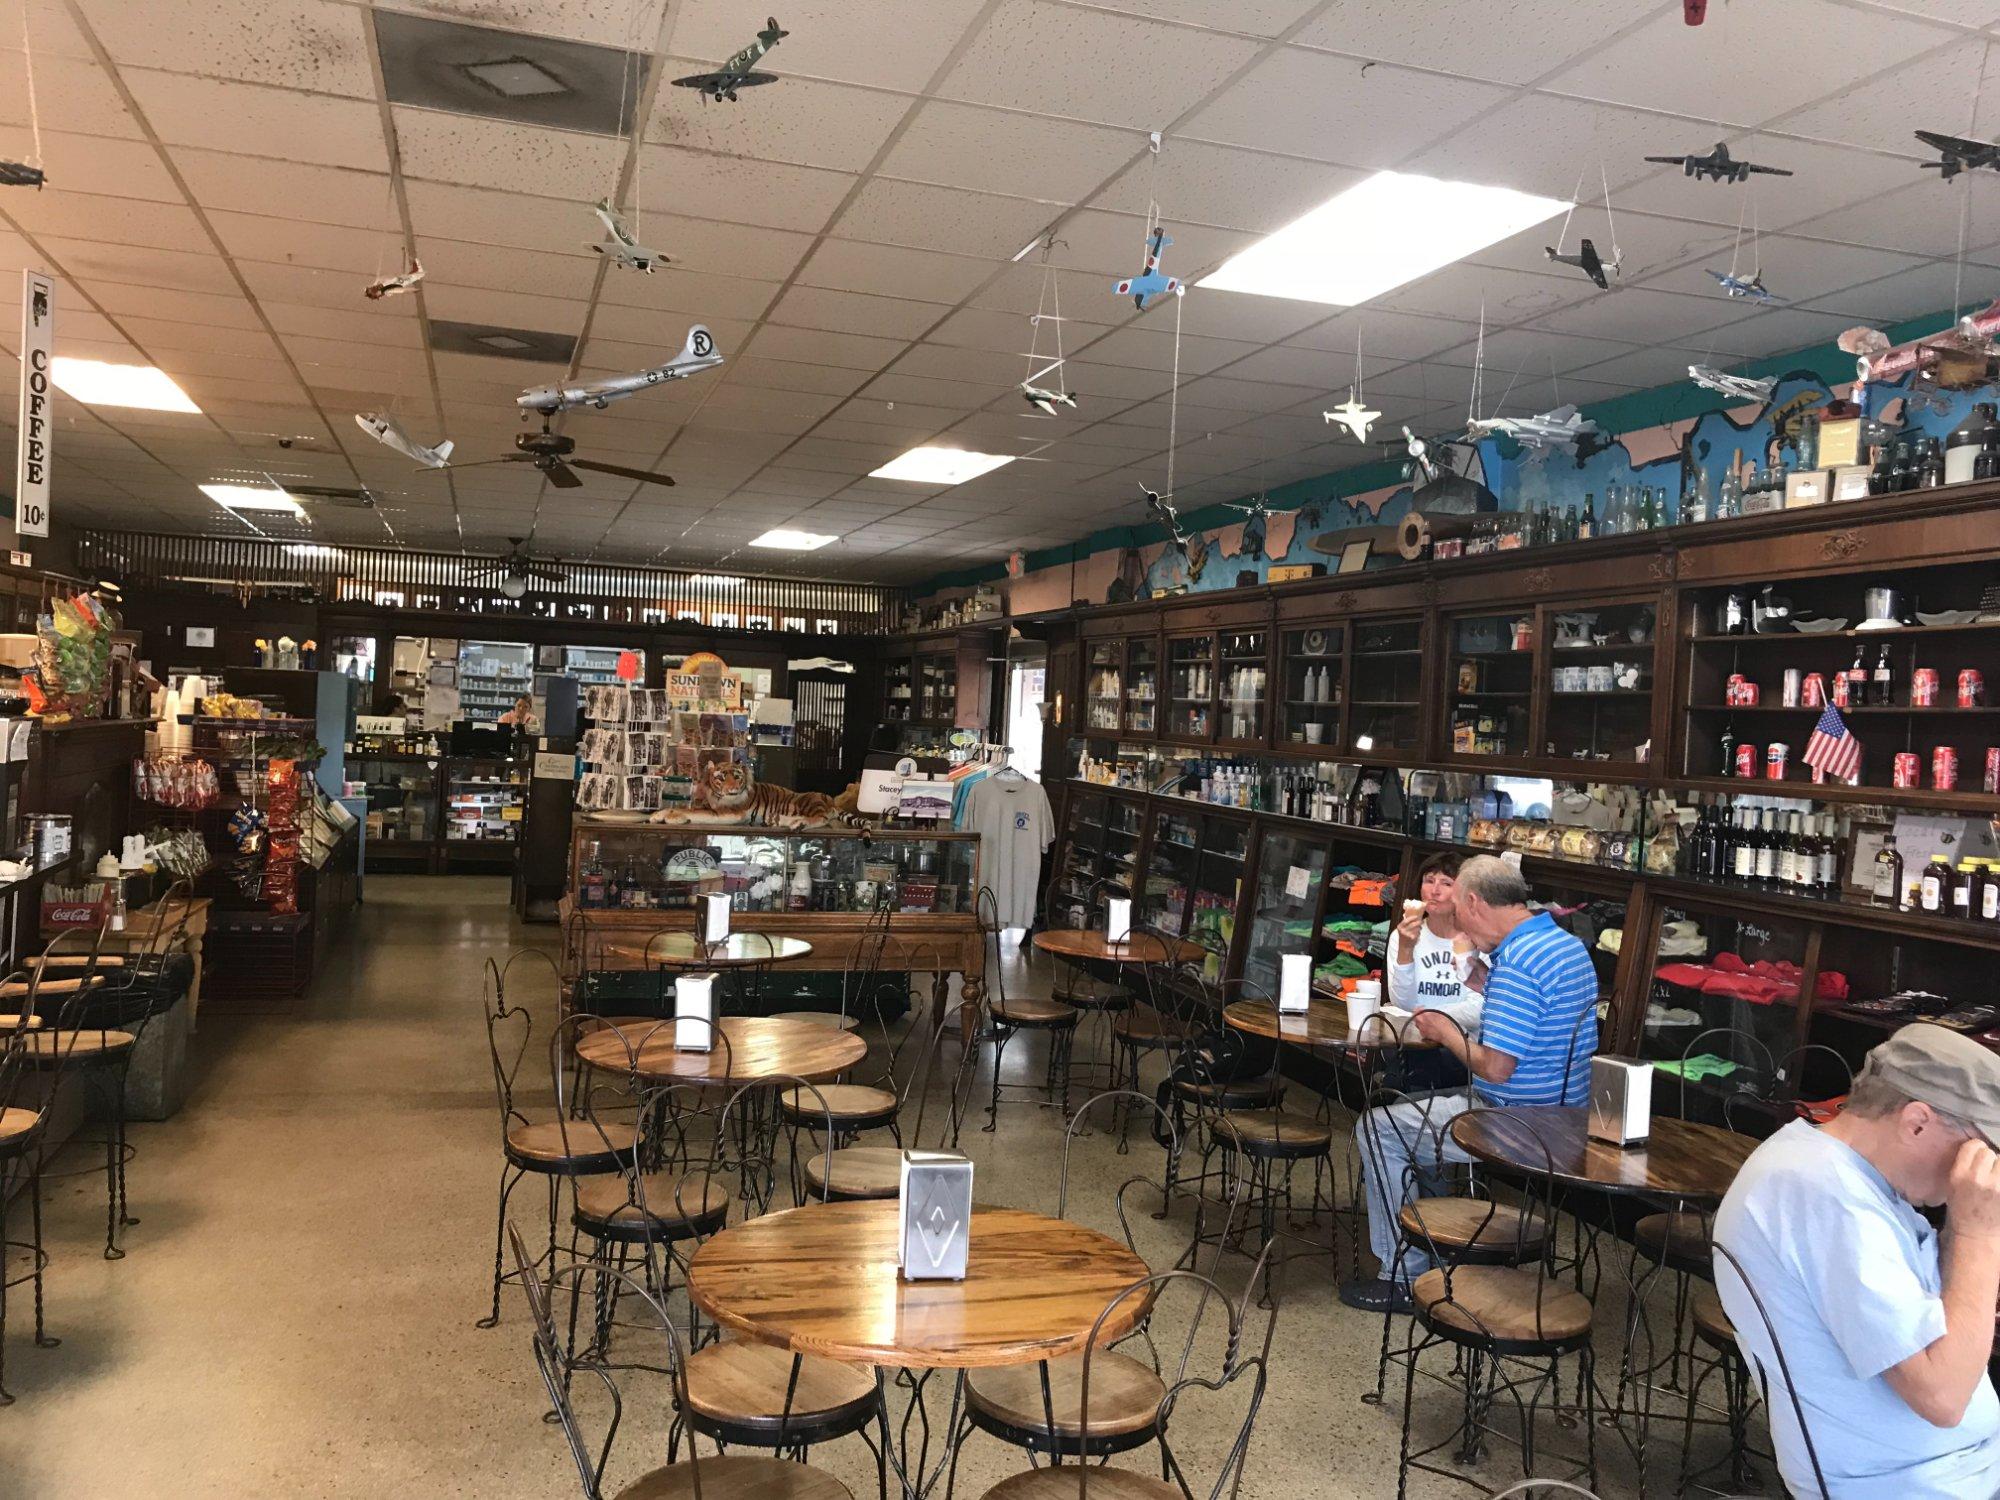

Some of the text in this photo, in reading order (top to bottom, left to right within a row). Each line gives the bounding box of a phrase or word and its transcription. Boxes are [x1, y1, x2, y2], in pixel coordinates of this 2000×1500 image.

[694, 335, 707, 352] R
[662, 368, 676, 379] 82
[27, 348, 48, 485] COFFEE
[23, 504, 45, 526] 10¢
[670, 674, 737, 689] SUNWN
[672, 849, 714, 865] PUBLIC
[1420, 950, 1452, 969] UND
